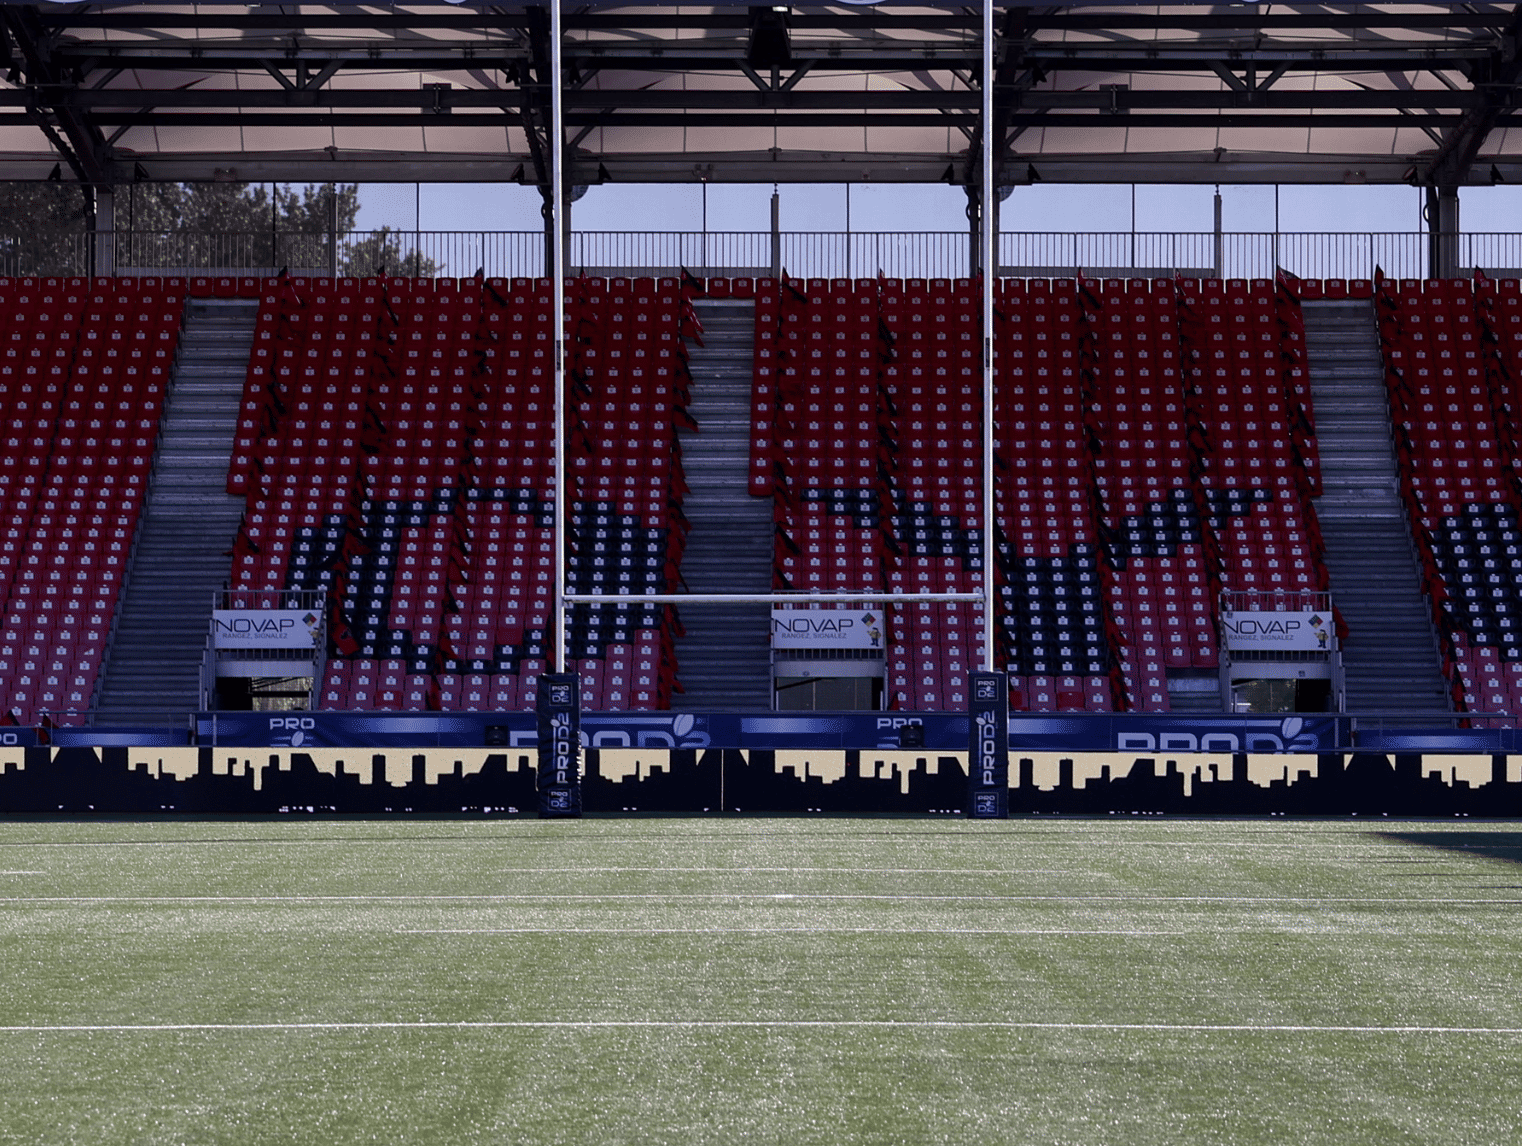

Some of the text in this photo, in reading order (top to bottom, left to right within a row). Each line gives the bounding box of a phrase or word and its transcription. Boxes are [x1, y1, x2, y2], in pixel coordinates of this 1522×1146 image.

[215, 618, 295, 633] NOVAP
[774, 618, 854, 632] NOVAP
[1224, 620, 1301, 634] NOVAP
[269, 717, 316, 730] PRO
